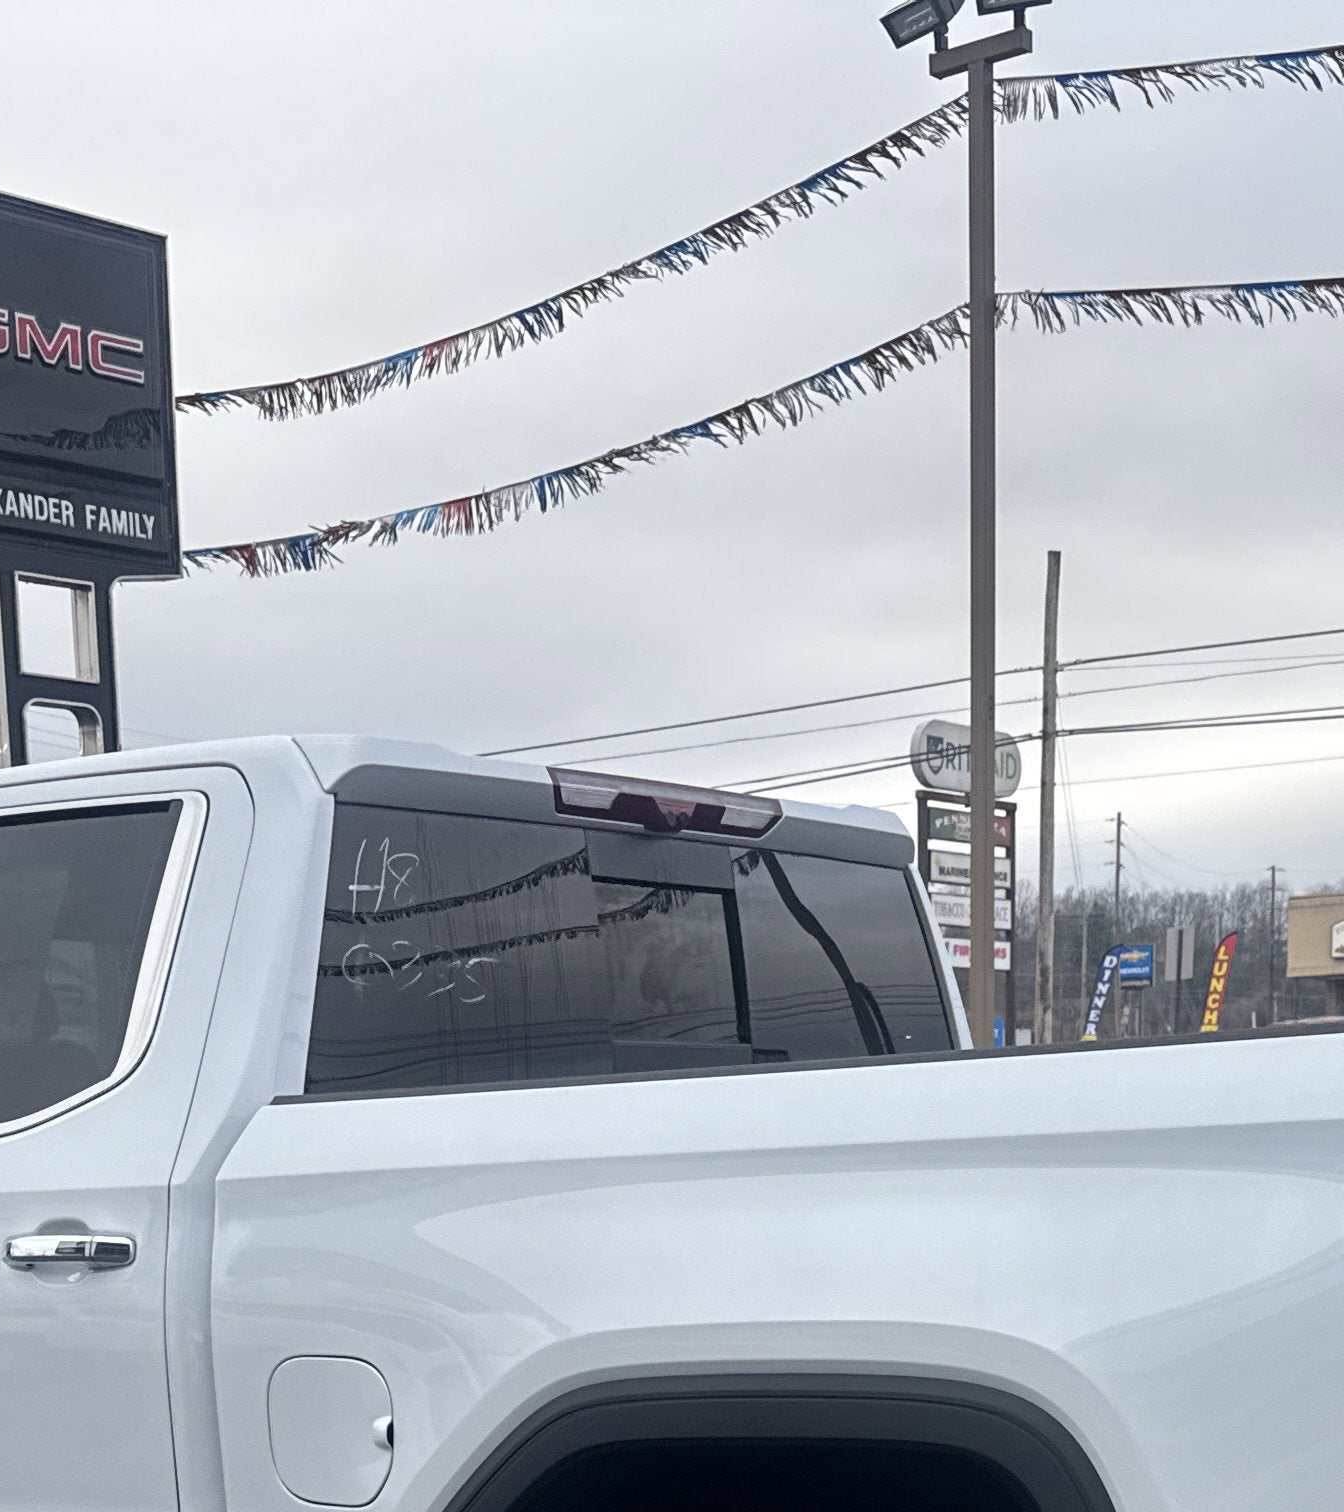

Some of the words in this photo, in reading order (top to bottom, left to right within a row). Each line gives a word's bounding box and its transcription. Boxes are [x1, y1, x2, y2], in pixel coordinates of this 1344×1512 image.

[85, 504, 155, 540] FAMILY
[1084, 955, 1118, 1035] DINNER
[1203, 945, 1229, 1025] LUNCH
